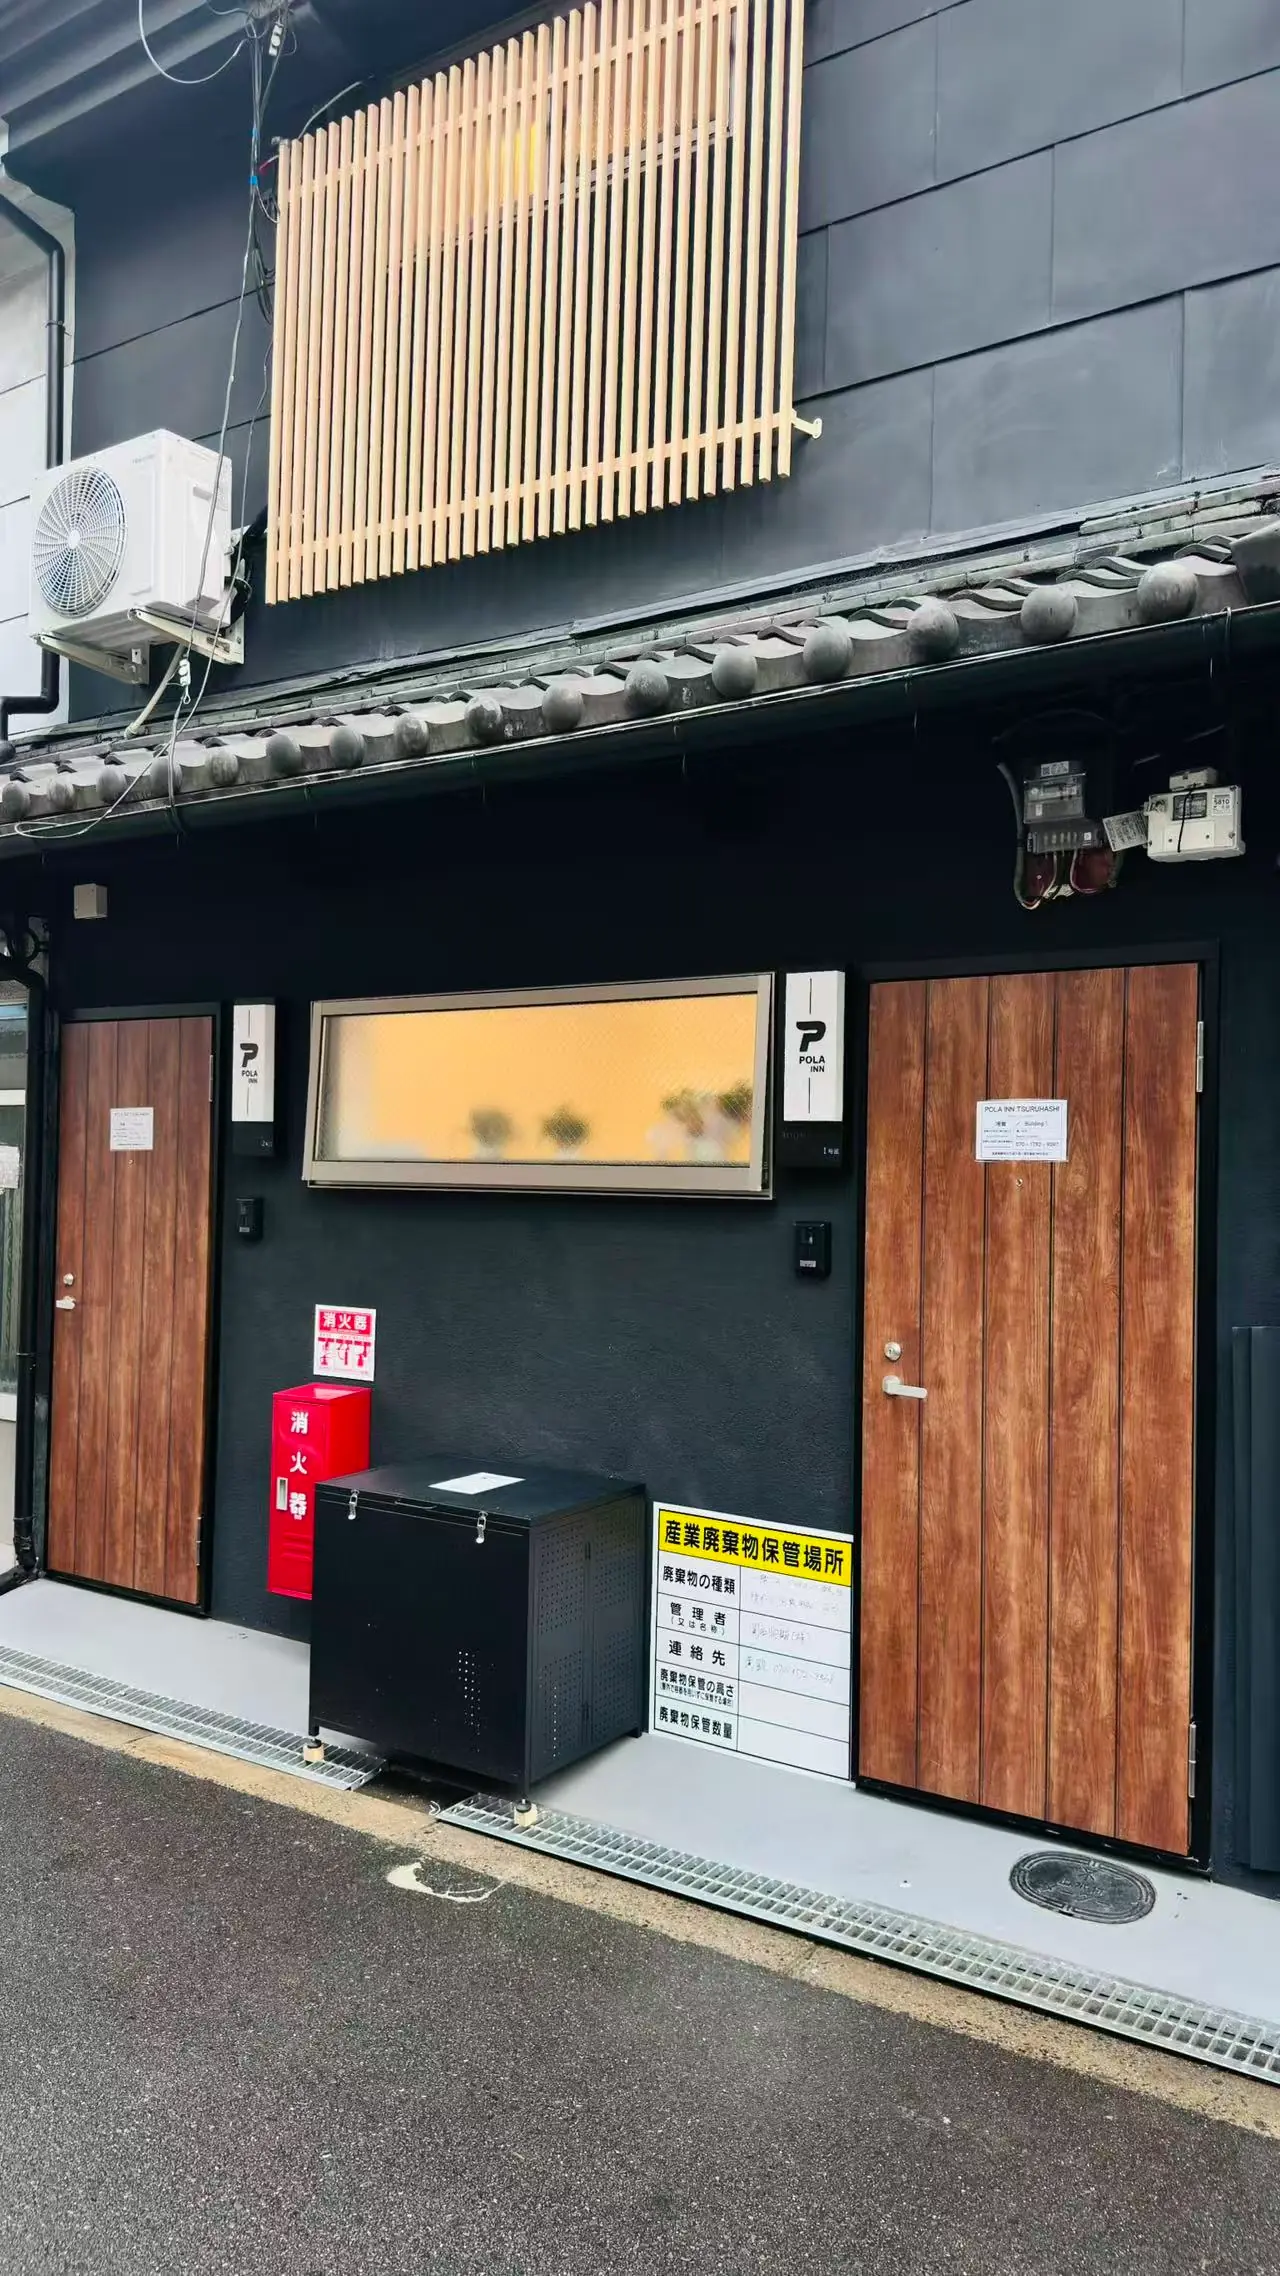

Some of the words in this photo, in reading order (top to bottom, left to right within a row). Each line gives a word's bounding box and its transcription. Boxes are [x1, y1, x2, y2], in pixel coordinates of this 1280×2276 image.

[798, 1055, 826, 1065] POLA
[810, 1065, 825, 1073] INN
[323, 1312, 367, 1330] 消火器
[290, 1411, 309, 1516] 消火器
[665, 1520, 844, 1577] 産業廃棄物保管場所
[663, 1565, 735, 1595] 廃棄物の種類
[670, 1602, 726, 1626] 管理者
[669, 1639, 726, 1666] 連絡先
[660, 1668, 734, 1697] 廃棄物保管の高さ
[660, 1706, 732, 1739] 廃棄物保管数量
